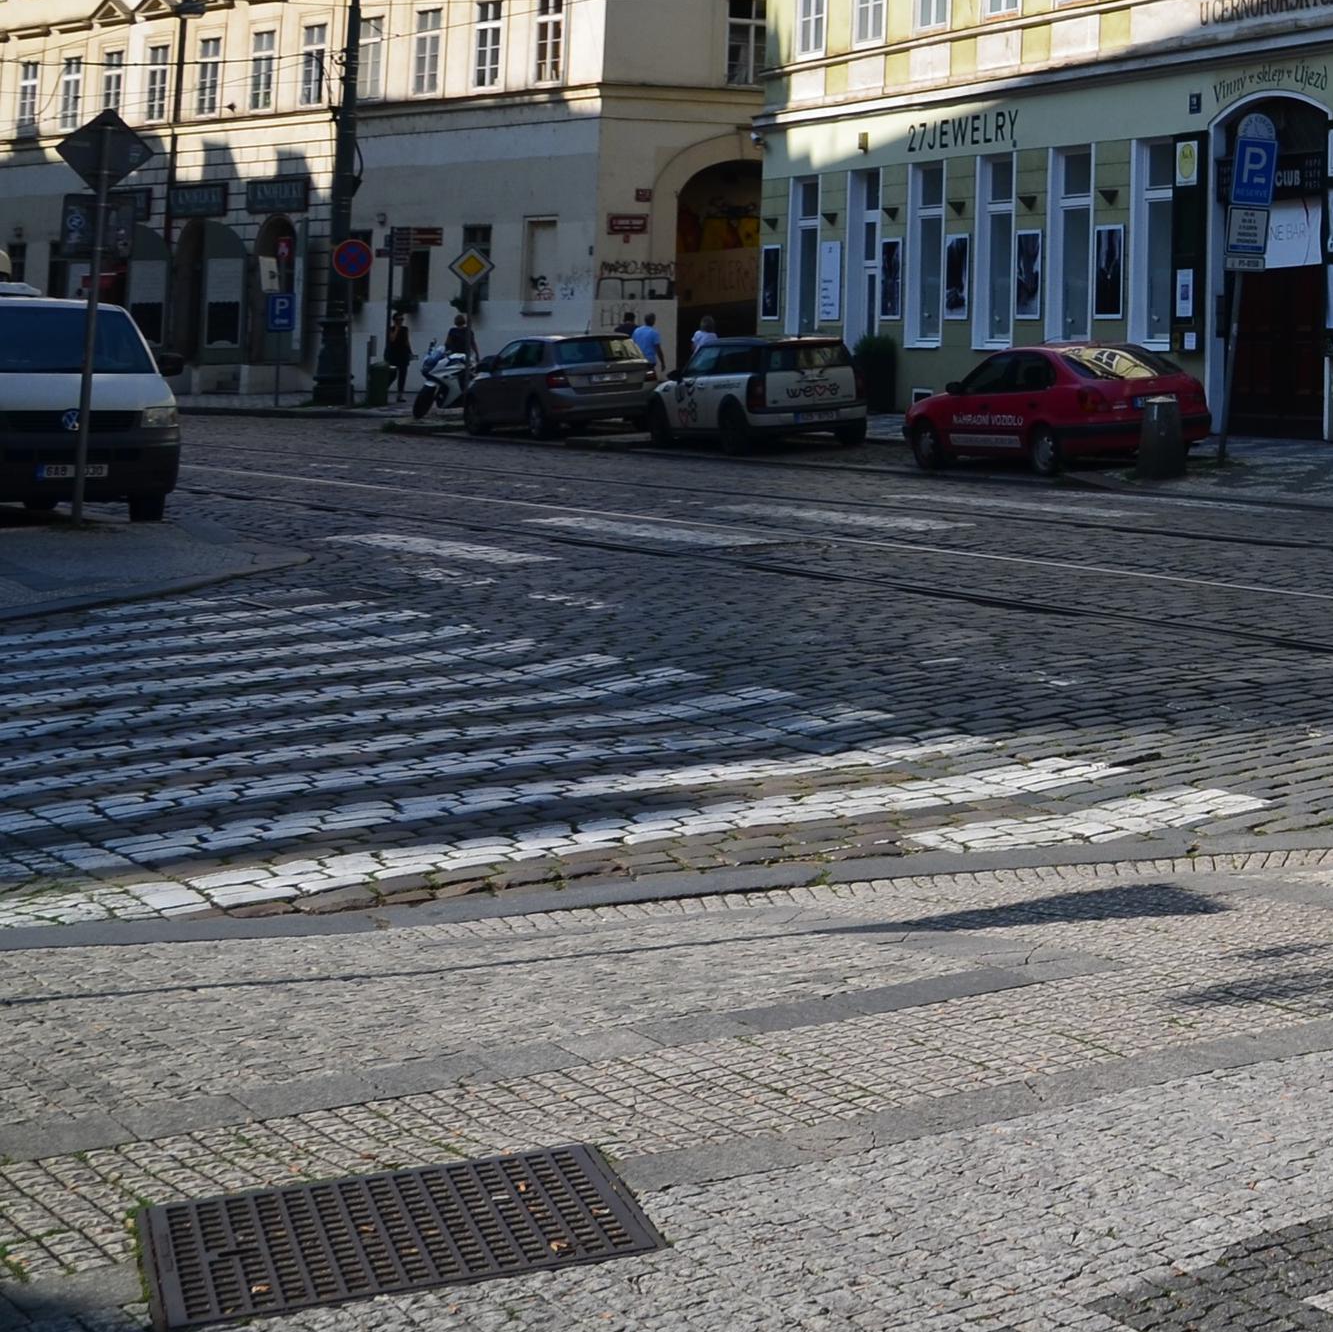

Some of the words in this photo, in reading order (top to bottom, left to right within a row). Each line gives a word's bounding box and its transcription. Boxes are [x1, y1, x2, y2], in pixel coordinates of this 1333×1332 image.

[1201, 1, 1209, 26] U
[1256, 64, 1284, 85] sklep
[907, 109, 1019, 152] 27JEWELRY
[1242, 146, 1267, 183] P
[1275, 169, 1301, 187] CLUB
[276, 298, 289, 315] P
[953, 412, 989, 425] NÁHRADNÍ
[991, 413, 1024, 427] VOZIDLO
